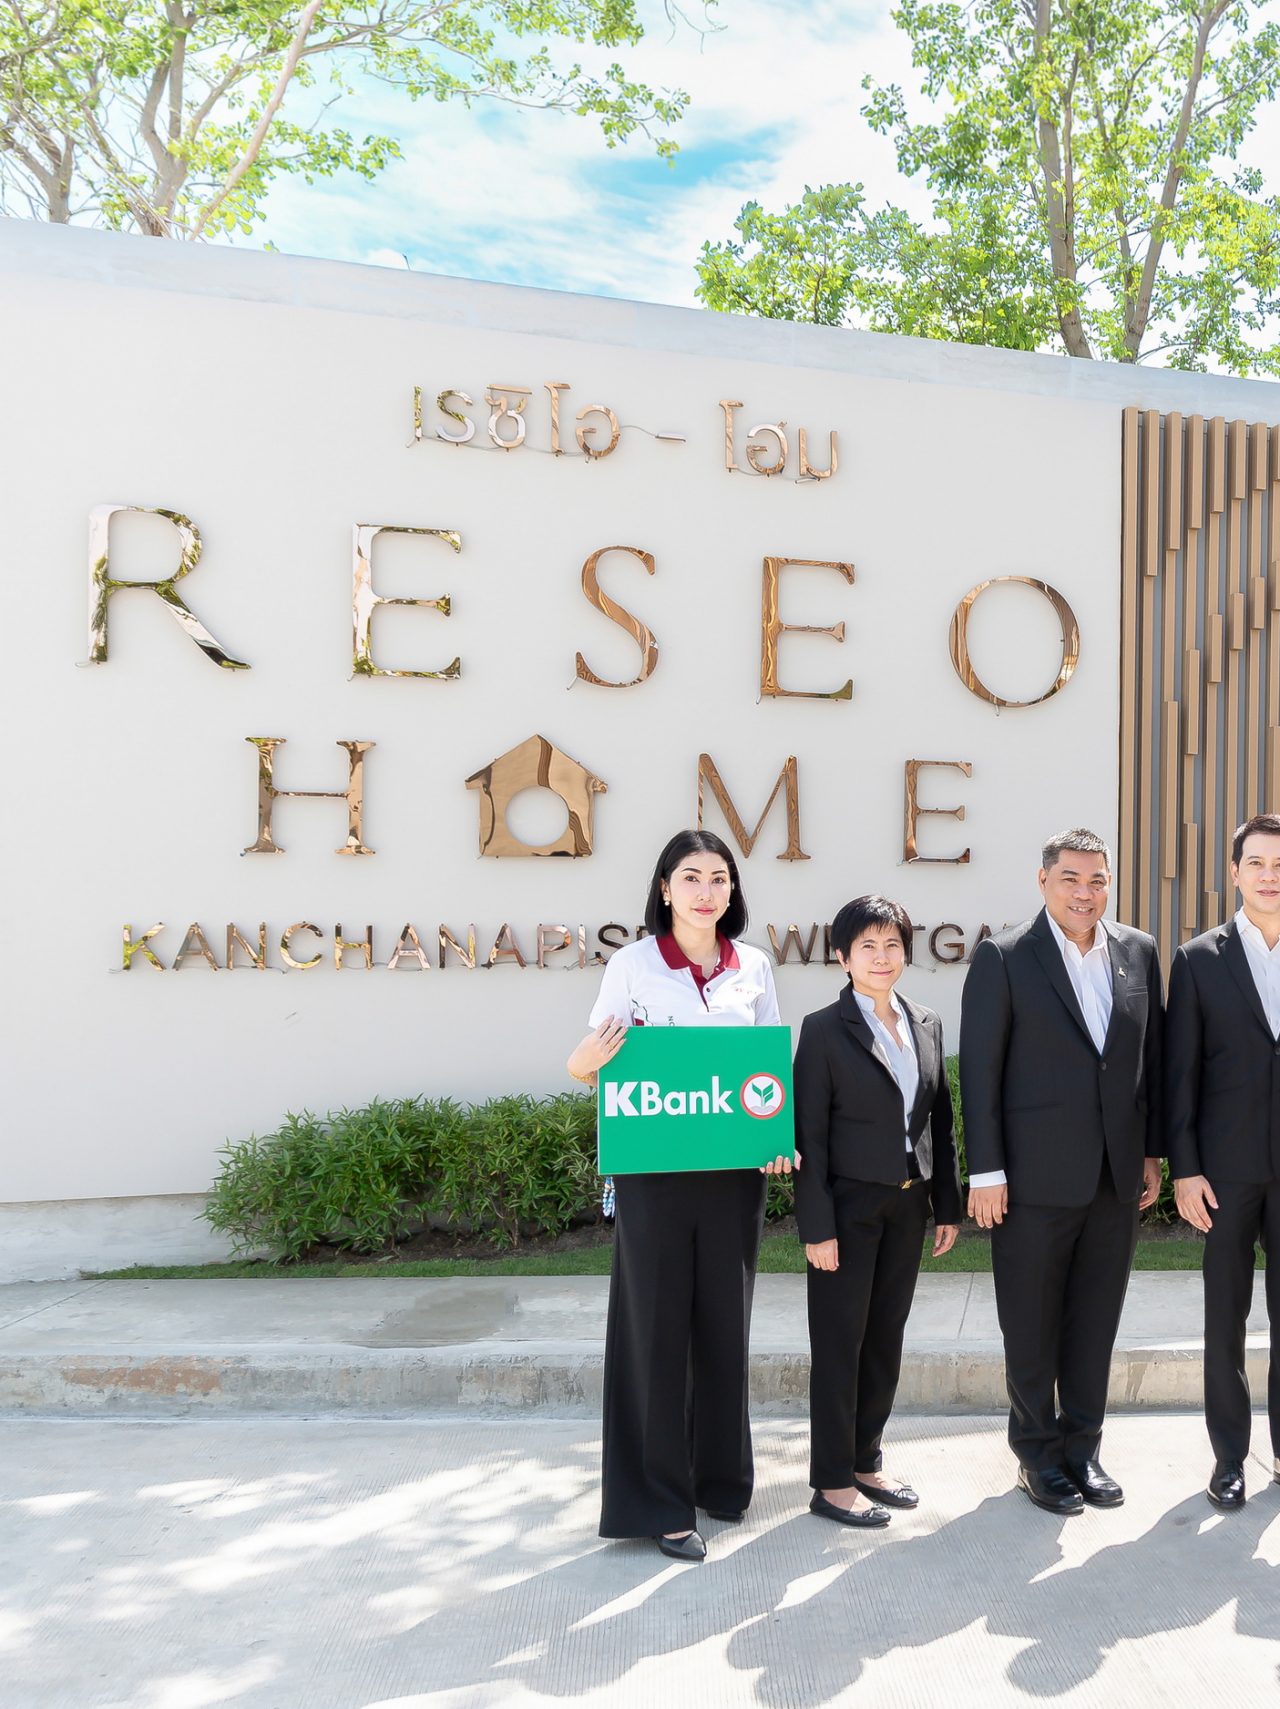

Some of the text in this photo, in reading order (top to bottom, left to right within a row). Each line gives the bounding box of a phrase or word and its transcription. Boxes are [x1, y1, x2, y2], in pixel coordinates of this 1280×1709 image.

[88, 503, 1081, 708] RESEO
[121, 921, 650, 970] KANCHANAPIS
[604, 1075, 734, 1118] KBank
